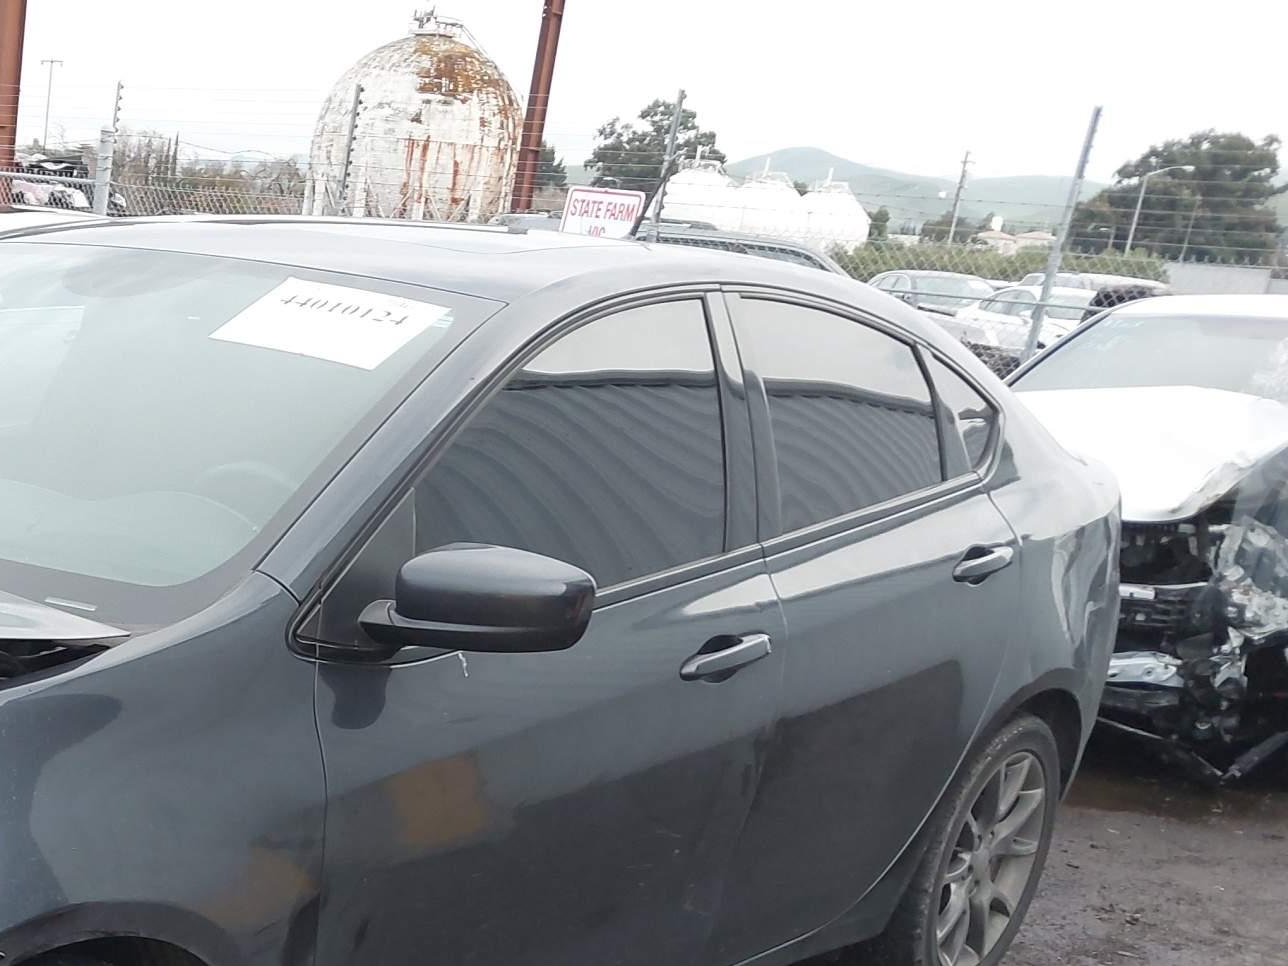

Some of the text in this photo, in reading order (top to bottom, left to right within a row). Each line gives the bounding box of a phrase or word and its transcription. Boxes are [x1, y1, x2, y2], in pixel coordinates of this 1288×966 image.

[570, 198, 637, 222] STATE FARM
[278, 295, 409, 326] 44010124
